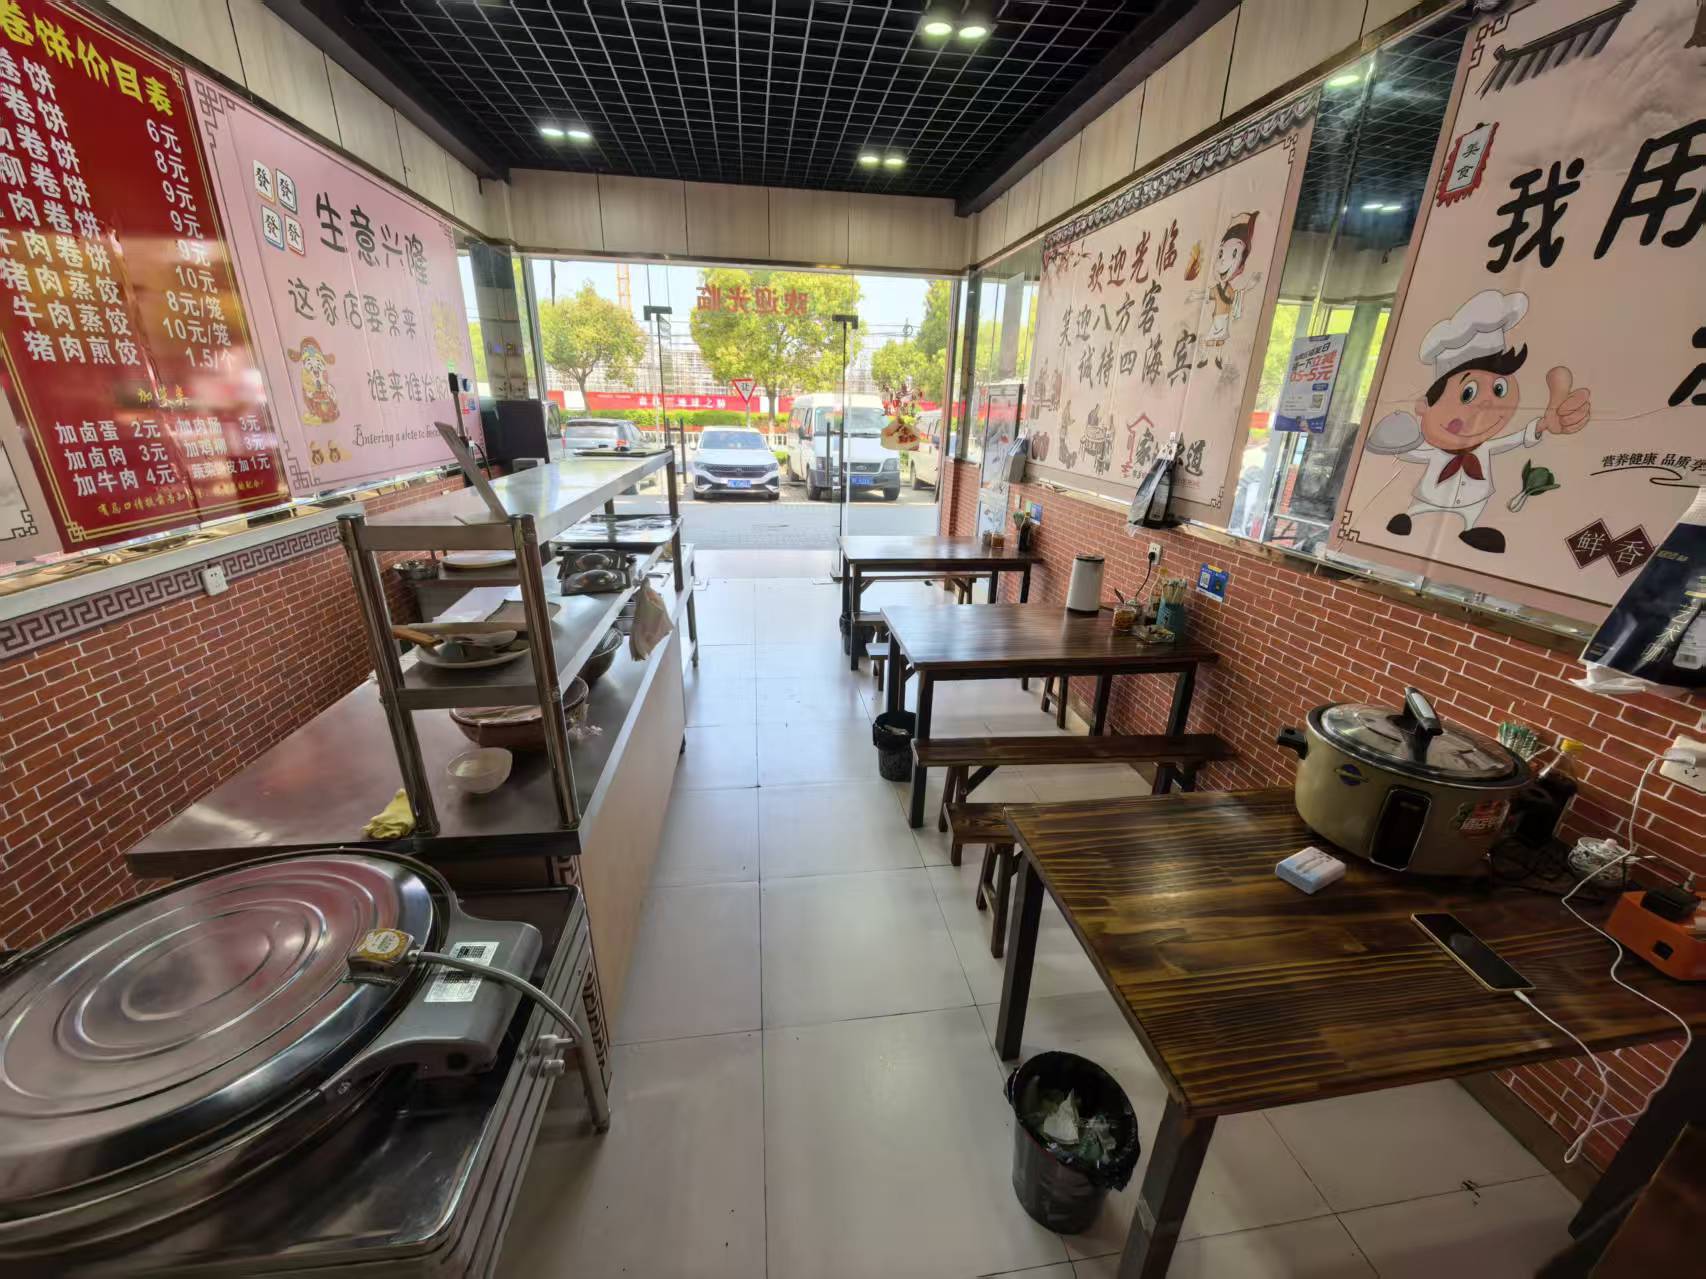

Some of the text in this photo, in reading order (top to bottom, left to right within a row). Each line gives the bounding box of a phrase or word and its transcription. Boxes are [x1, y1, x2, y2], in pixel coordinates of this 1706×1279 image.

[1, 83, 189, 184] 卷饼 8元
[145, 118, 182, 154] 6元
[1456, 141, 1481, 180] 美食
[163, 182, 196, 212] 9元
[1486, 118, 1706, 273] 我用
[0, 190, 211, 267] 肉卷饼 9元
[170, 210, 203, 240] 9元
[316, 191, 429, 286] 生意兴隆
[1088, 219, 1179, 294] 欢迎光临
[0, 257, 123, 306] 猪肉蒸饺
[176, 265, 218, 295] 10元
[14, 295, 132, 336] 牛肉蒸饺
[1060, 280, 1161, 347] 笑迎八方客
[24, 330, 141, 366] 猪肉煎饺
[55, 421, 120, 444] 加卤蛋
[131, 418, 161, 439] 2元
[238, 415, 261, 432] 3元
[64, 447, 127, 470] 加卤肉
[139, 443, 168, 463] 3元
[243, 434, 265, 450] 3元
[1602, 452, 1658, 467] 营养健康
[73, 470, 139, 496] 加牛肉
[147, 464, 176, 486] 4元
